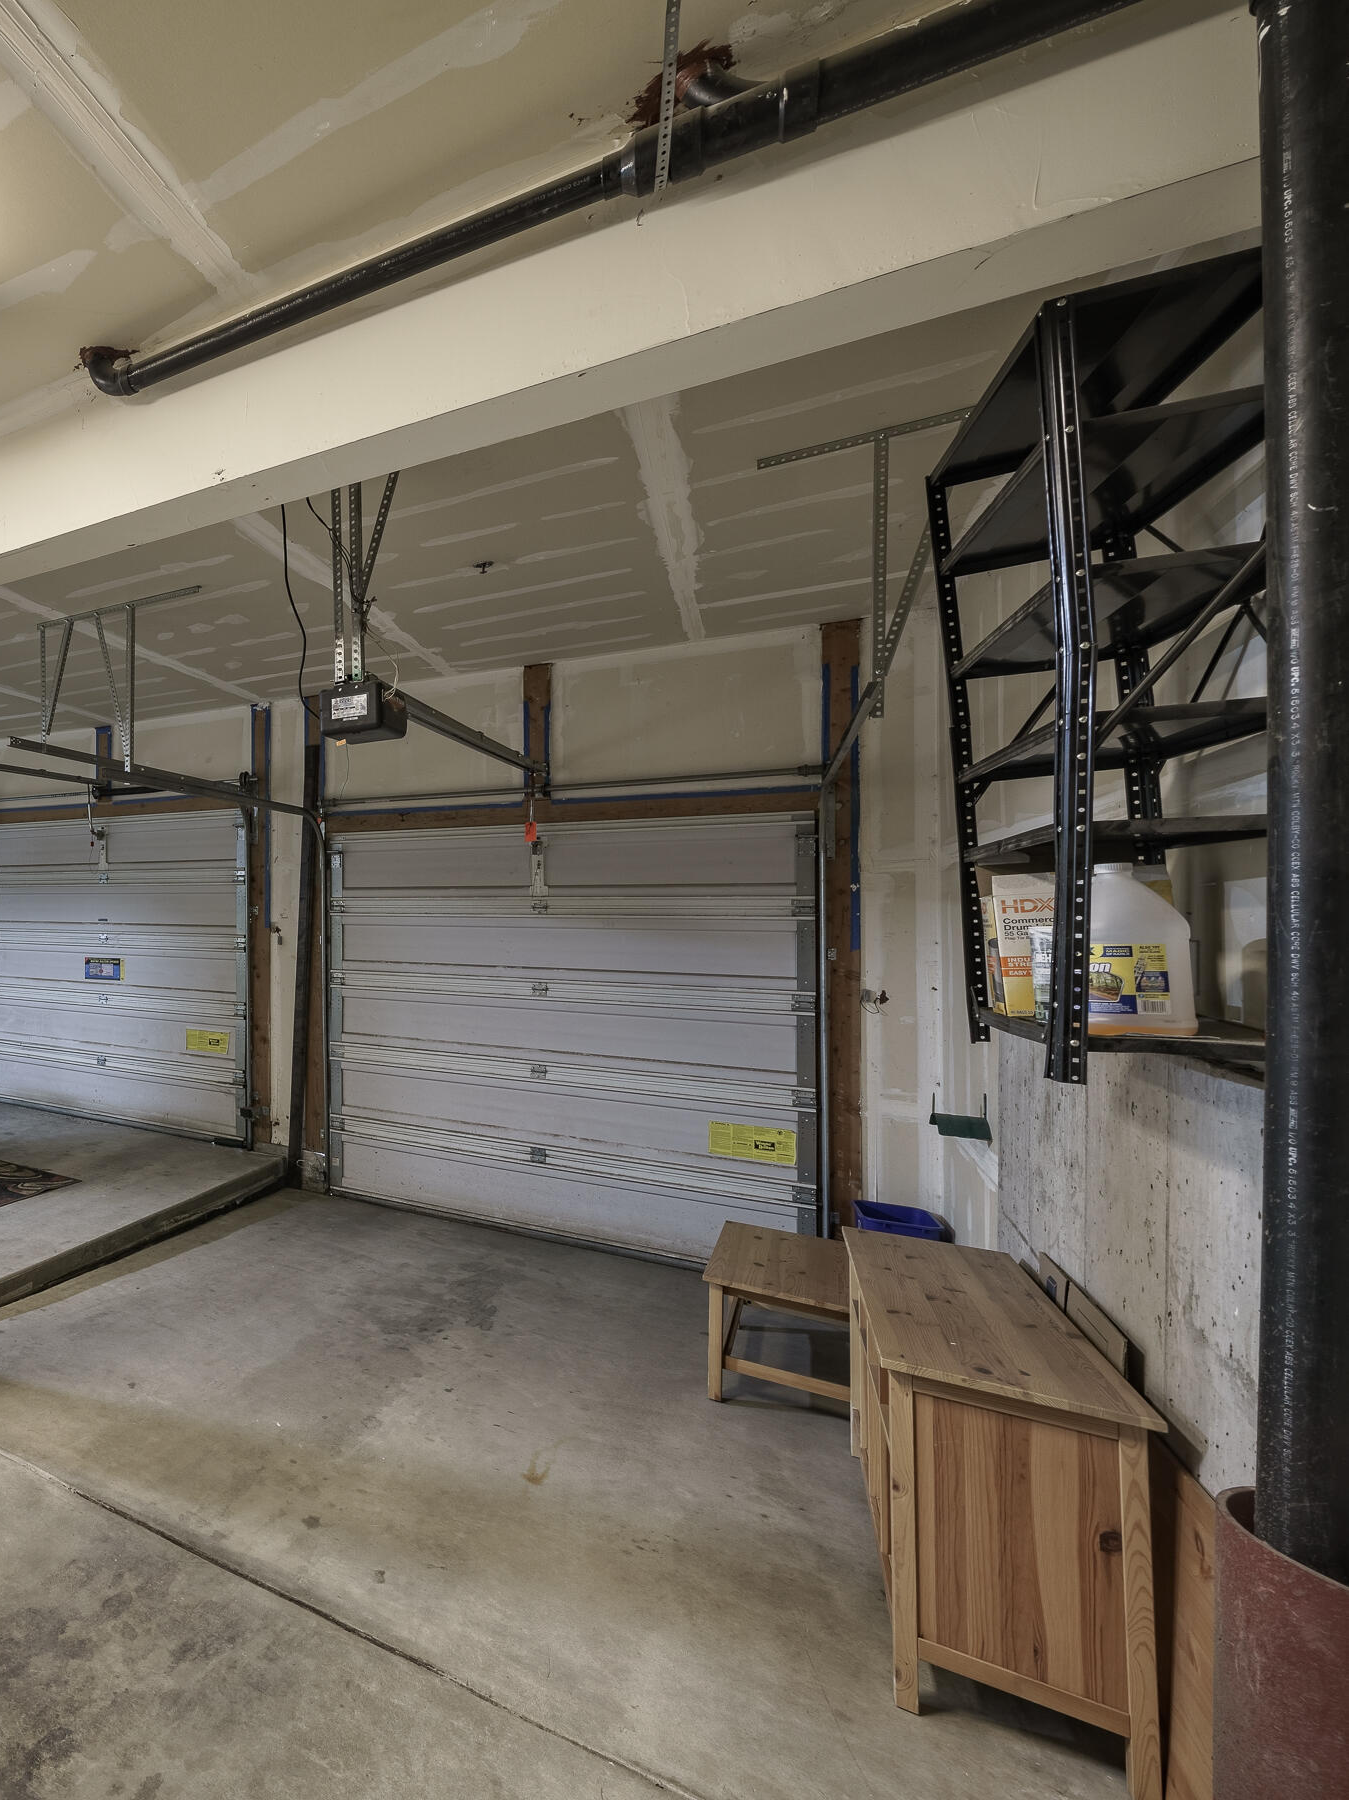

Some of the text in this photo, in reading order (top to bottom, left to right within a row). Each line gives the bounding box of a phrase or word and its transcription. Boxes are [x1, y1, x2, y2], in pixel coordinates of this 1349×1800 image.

[1291, 873, 1301, 888] ABS
[1001, 897, 1055, 914] HDX
[1291, 890, 1301, 929] CELLULAR
[1291, 953, 1300, 970] DWV
